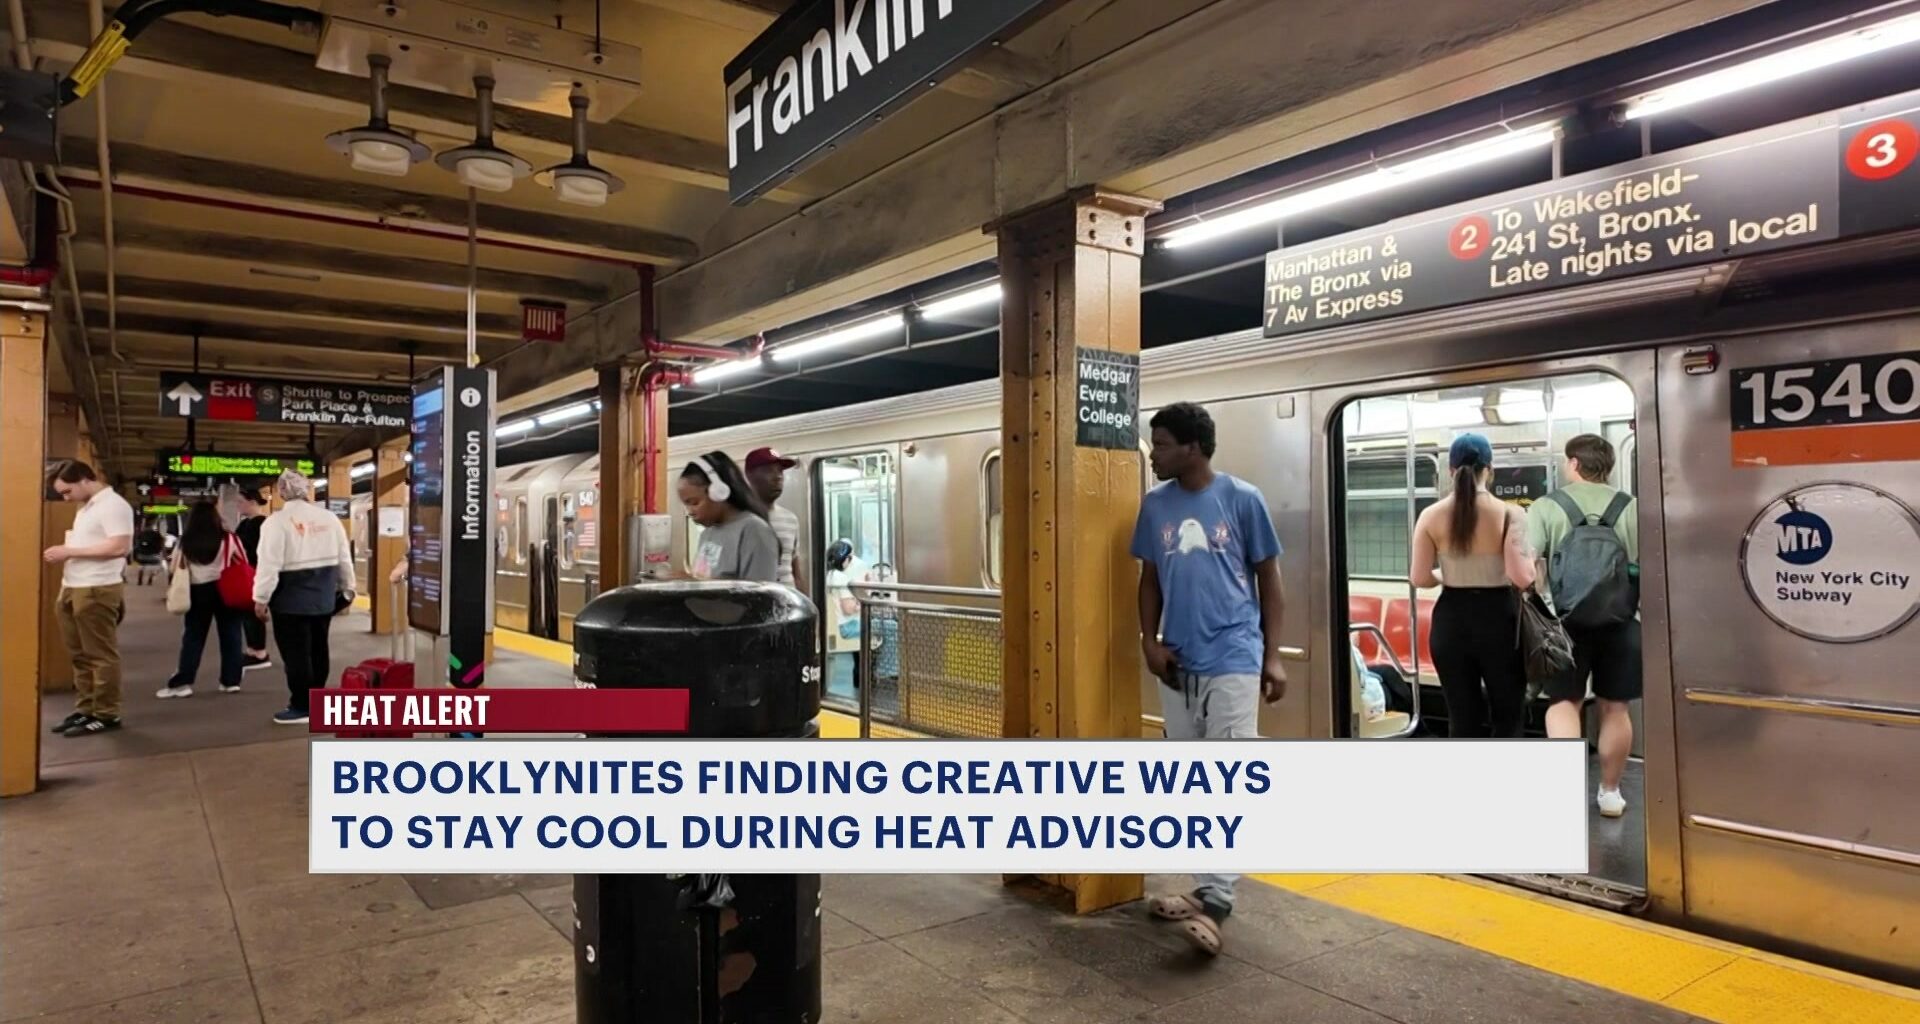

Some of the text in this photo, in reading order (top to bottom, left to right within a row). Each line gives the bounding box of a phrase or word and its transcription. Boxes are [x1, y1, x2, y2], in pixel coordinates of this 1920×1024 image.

[1865, 133, 1898, 168] 3
[1491, 202, 1700, 261] 241 St, Bronx.
[1492, 208, 1522, 232] To
[1460, 224, 1478, 251] 2
[1490, 203, 1817, 288] Late nights via local
[1267, 234, 1398, 283] Manhattan &
[1267, 258, 1412, 305] The Bronx via
[1266, 288, 1404, 328] 7 Av Express
[1080, 363, 1131, 386] Medgar
[210, 381, 252, 398] Exit
[263, 389, 275, 401] S
[282, 385, 333, 399] Shuttle
[339, 389, 352, 401] to
[357, 391, 410, 405] Prospec
[1080, 384, 1118, 404] Evers
[1740, 359, 1920, 425] 1540
[281, 409, 336, 423] Franklin
[282, 397, 373, 414] Park Place &
[1080, 406, 1131, 429] College
[461, 430, 481, 541] Information
[1775, 523, 1823, 554] MTA
[1776, 571, 1910, 590] New York City
[1777, 587, 1852, 606] Subway
